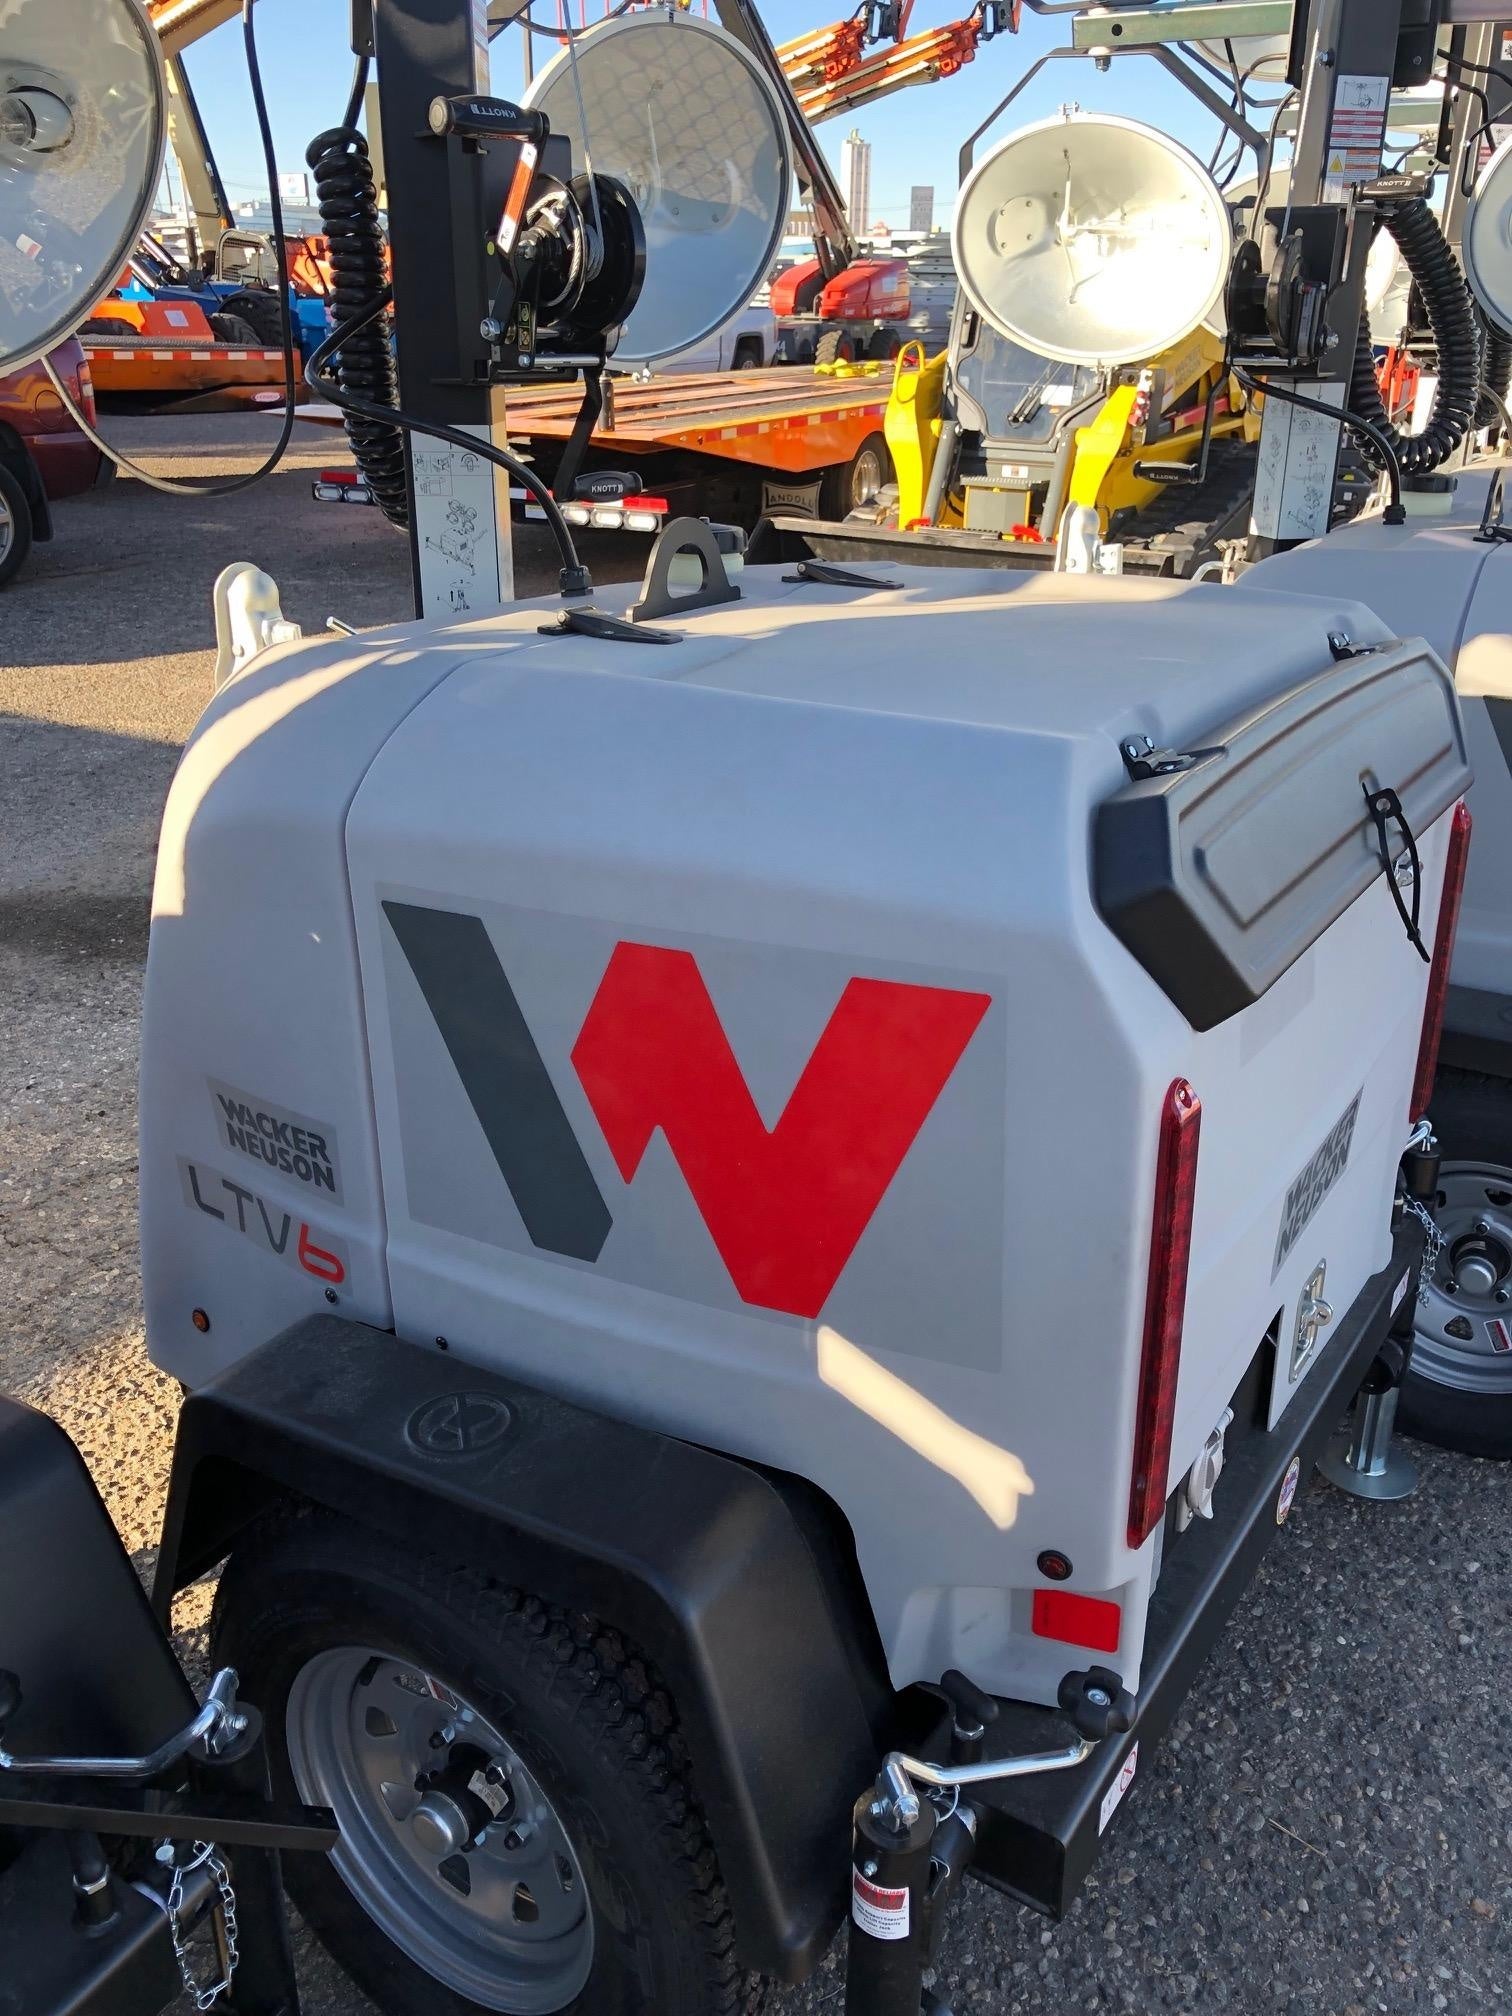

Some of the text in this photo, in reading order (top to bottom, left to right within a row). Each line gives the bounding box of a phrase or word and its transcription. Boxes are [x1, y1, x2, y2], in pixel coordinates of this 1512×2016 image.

[481, 106, 518, 120] KNOTT
[591, 484, 617, 494] KNOTT
[216, 1092, 332, 1165] WACKER
[226, 1120, 336, 1193] NEUSON
[1286, 1098, 1359, 1222] WACKER
[1276, 1131, 1352, 1268] NEUSON
